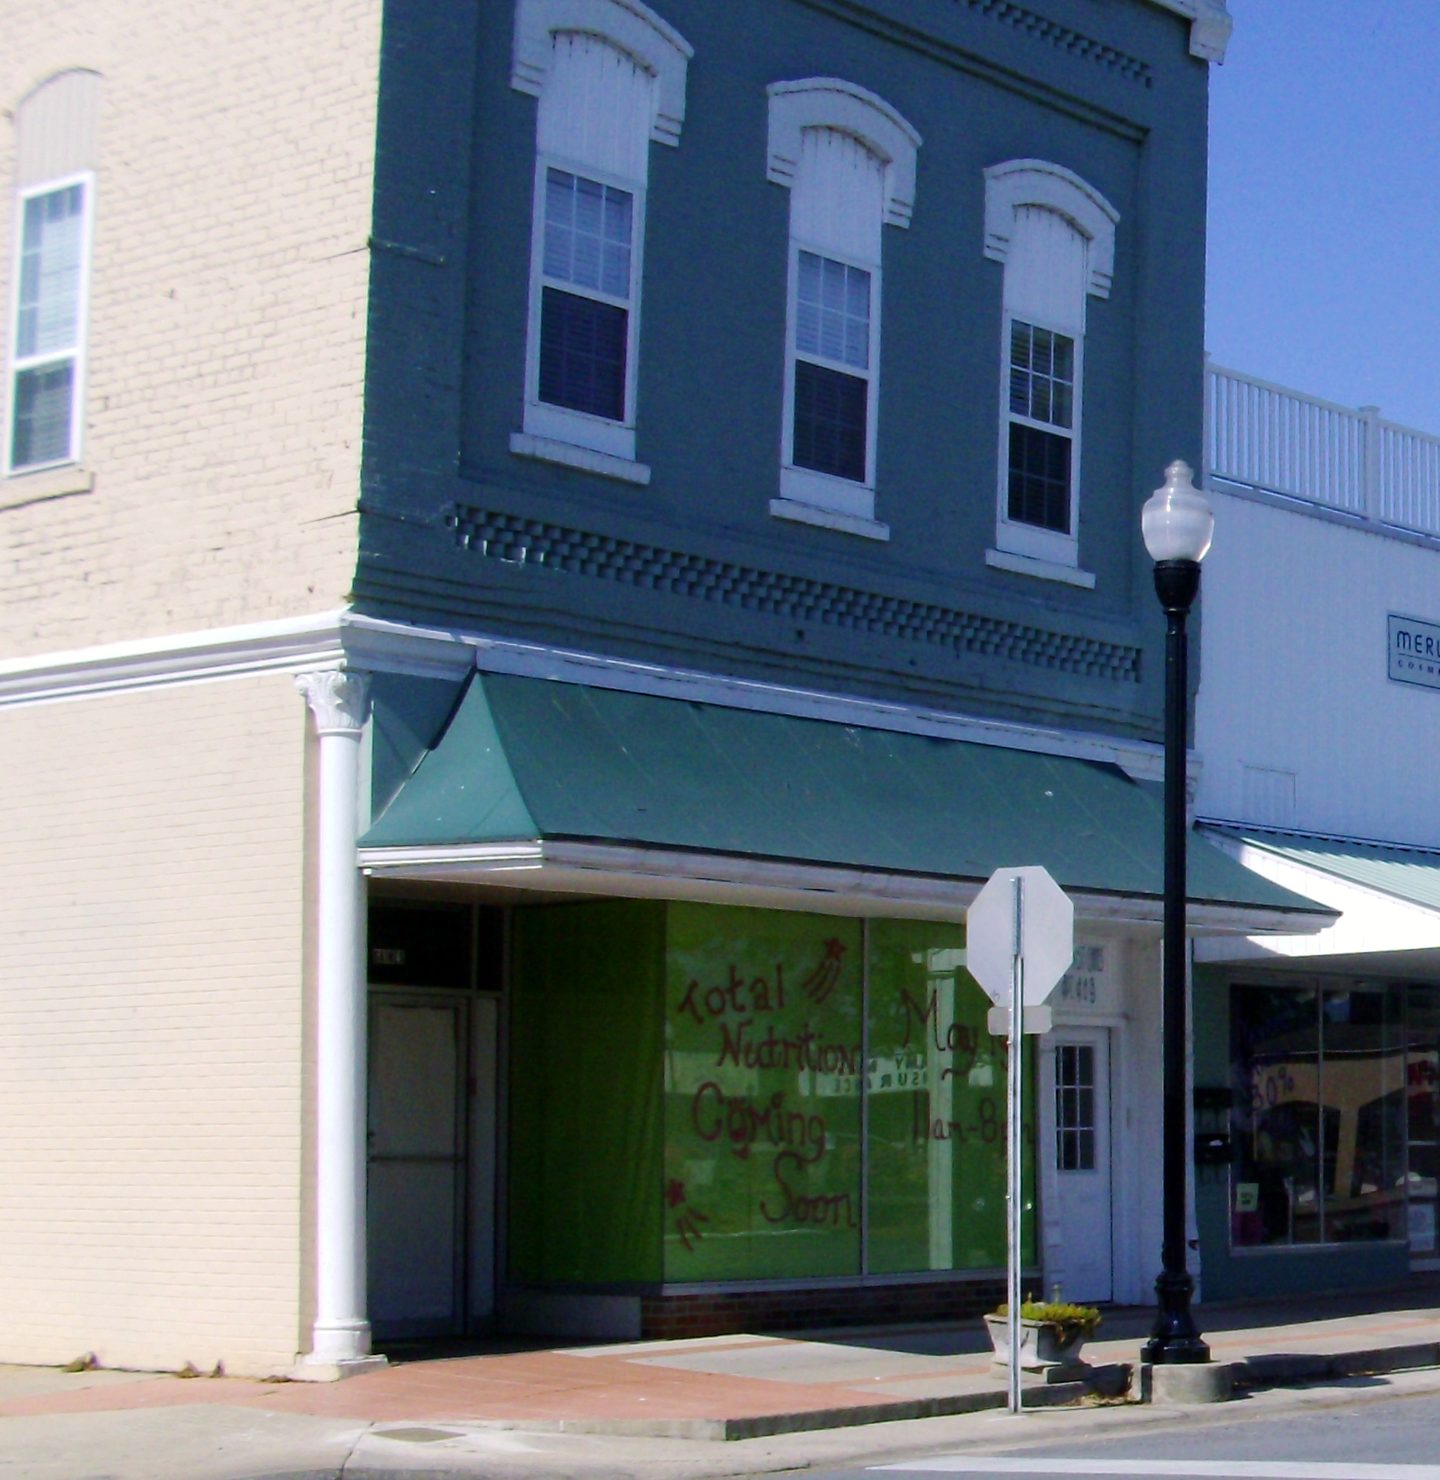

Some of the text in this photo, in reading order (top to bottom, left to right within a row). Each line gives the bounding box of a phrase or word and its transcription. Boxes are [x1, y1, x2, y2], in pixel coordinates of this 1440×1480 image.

[678, 963, 785, 1024] Total
[716, 1017, 864, 1076] Nutrition
[901, 986, 979, 1081] May
[692, 1081, 826, 1163] Coming
[760, 1150, 857, 1228] Soon
